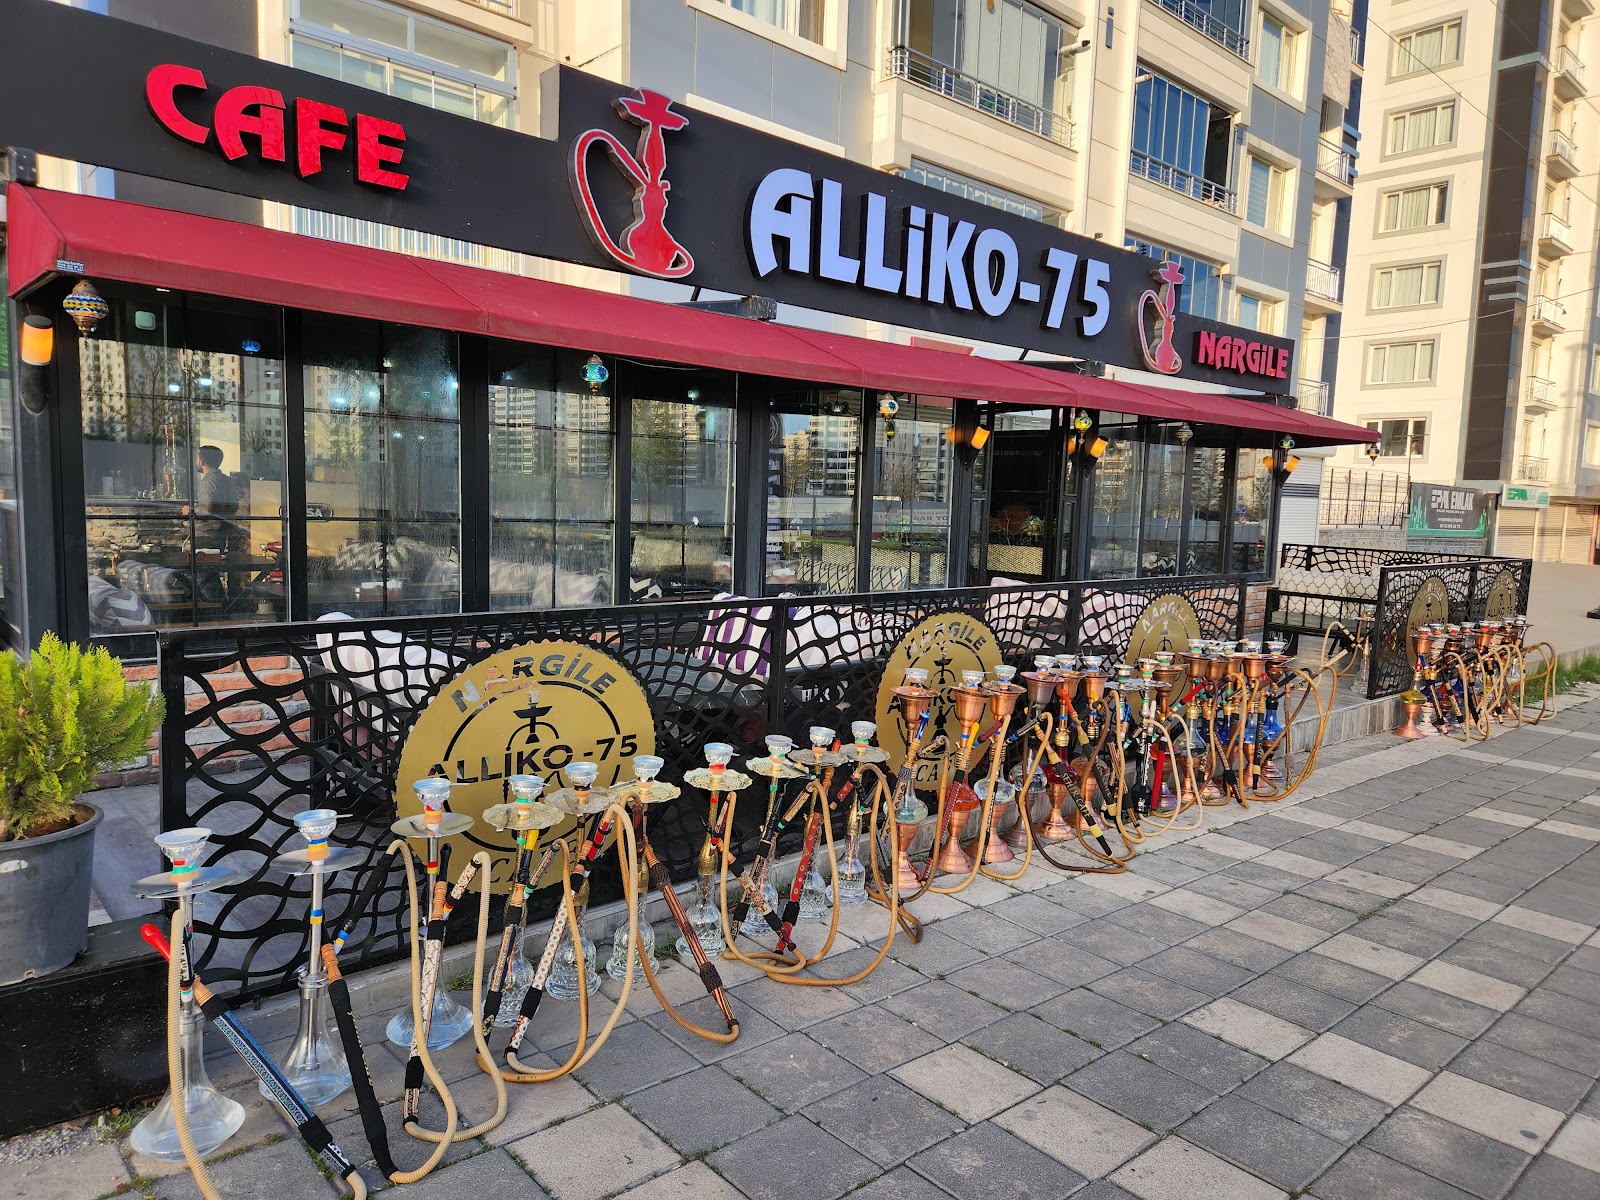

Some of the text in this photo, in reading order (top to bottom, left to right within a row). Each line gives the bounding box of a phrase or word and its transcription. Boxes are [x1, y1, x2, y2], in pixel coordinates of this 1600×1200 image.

[145, 64, 411, 191] CAFE
[1451, 491, 1474, 511] EMLAK
[904, 621, 987, 660] NARGİLE
[451, 652, 617, 714] NARGİLE
